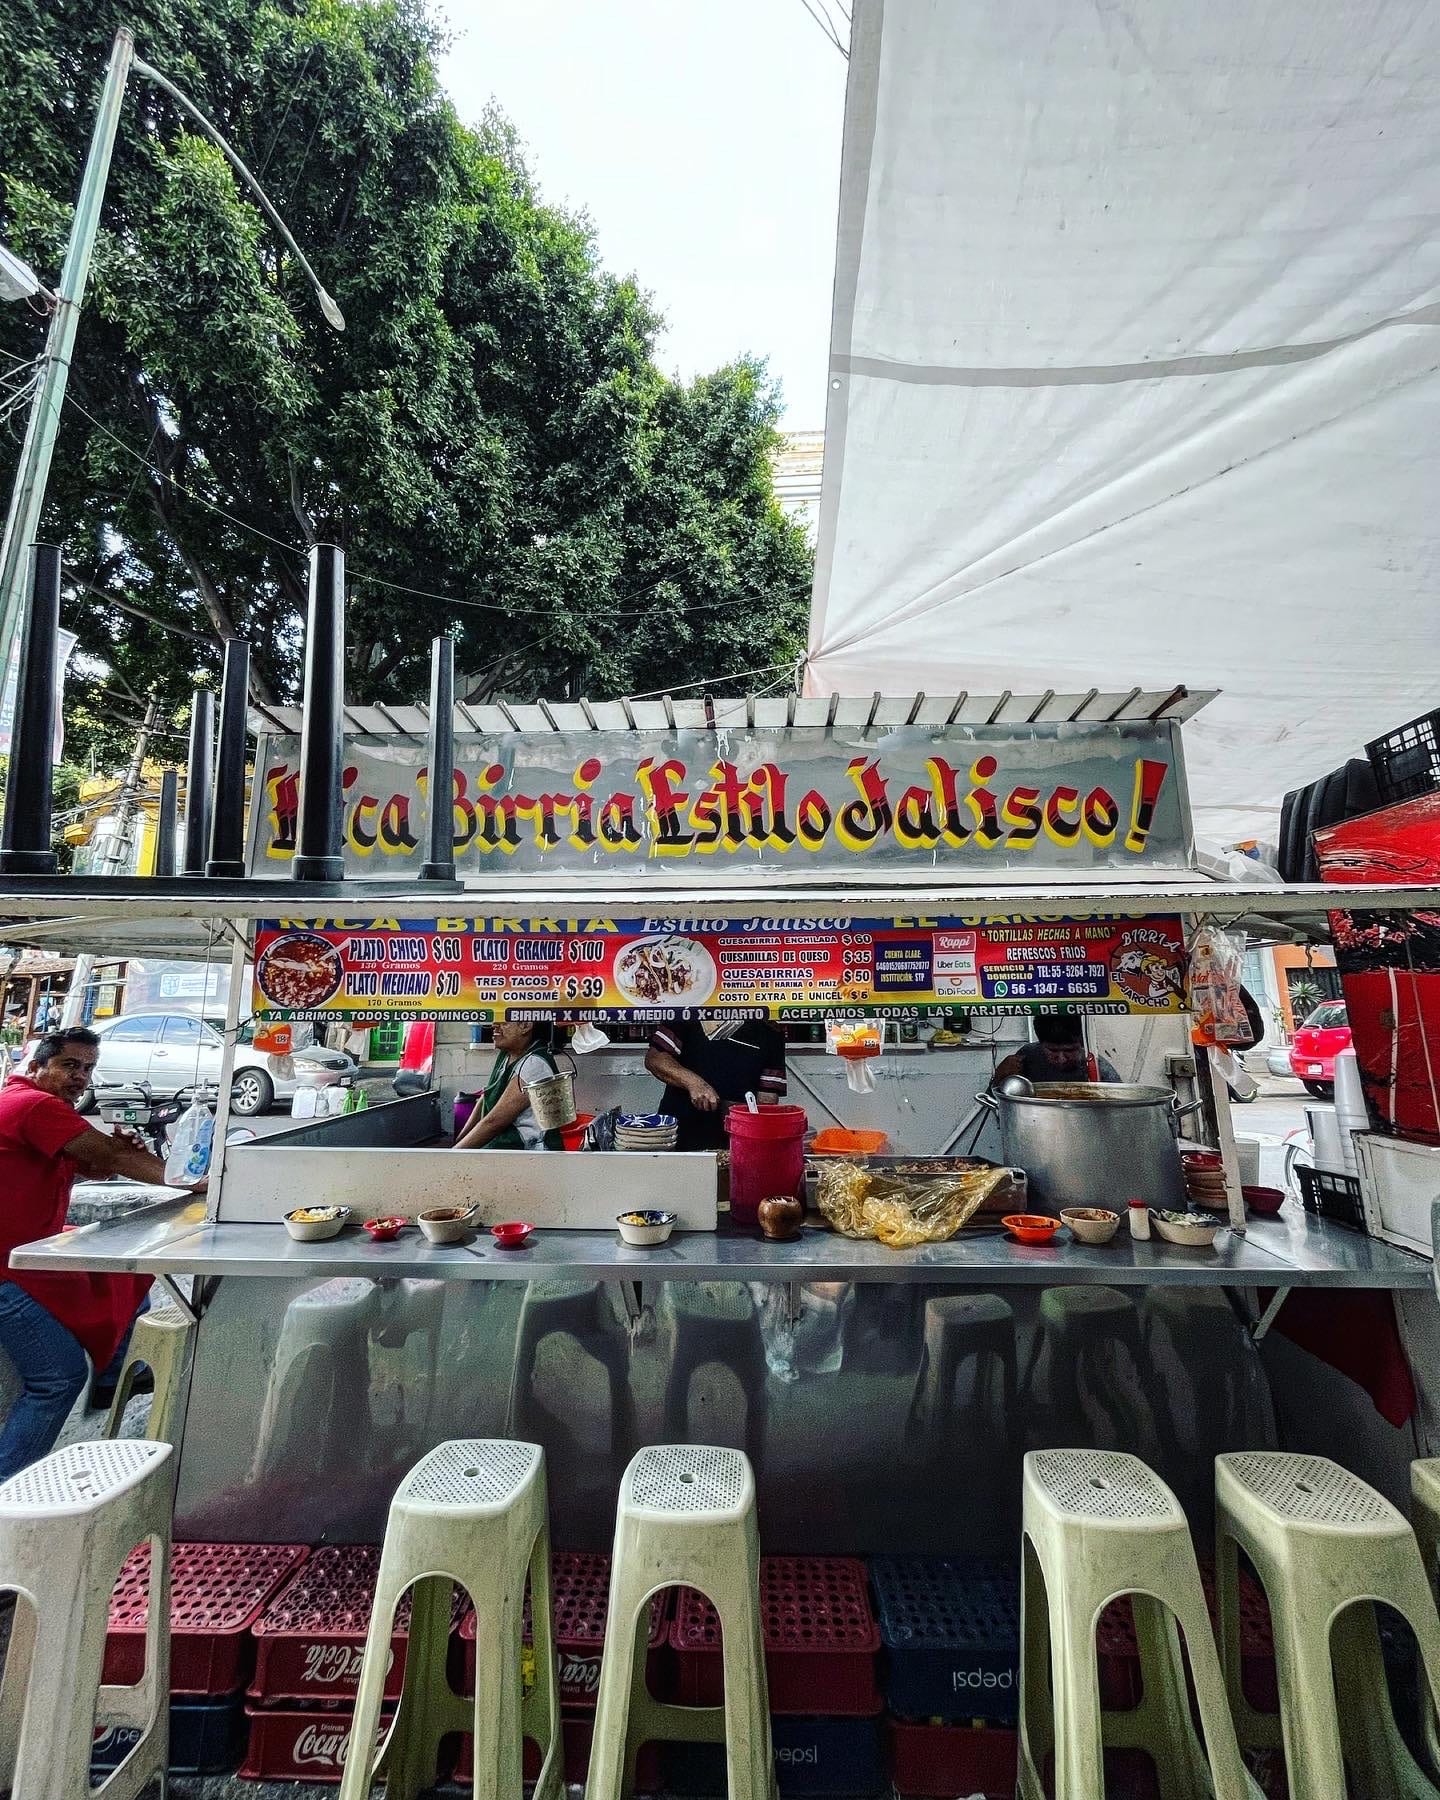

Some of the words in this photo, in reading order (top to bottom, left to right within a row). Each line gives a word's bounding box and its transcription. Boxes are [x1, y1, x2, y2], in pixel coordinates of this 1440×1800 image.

[267, 764, 419, 859] ca
[634, 757, 836, 858] Estilo
[719, 937, 780, 945] QUESABIRRIA
[785, 936, 837, 944] ENCHILADA
[1037, 928, 1070, 941] HECHAS
[1074, 928, 1081, 940] A
[1121, 928, 1181, 952] BIRRIA
[939, 935, 971, 949] Rappi
[348, 938, 385, 962] PLATO
[388, 938, 427, 961] CHICO
[473, 939, 509, 962] PLATO
[515, 939, 564, 962] GRANDE
[1006, 946, 1057, 961] REFRESCOS
[720, 951, 778, 963] QUESADILLAS
[783, 951, 795, 962] DE
[801, 951, 829, 962] QUESO
[382, 961, 421, 969] Gramos
[492, 963, 508, 971] 220
[512, 962, 549, 971] Gramos
[955, 960, 971, 968] Eats
[723, 969, 813, 979] QUESABIRRIAS
[1110, 972, 1125, 982] EL
[346, 972, 377, 996] PLATO
[381, 972, 431, 996] MEDIANO
[476, 977, 505, 986] TRES
[511, 977, 548, 986] TACOS
[553, 977, 562, 986] Y
[481, 991, 497, 1001] UN
[503, 989, 559, 1001] CONSOMÉ
[719, 993, 750, 1001] COSTO
[755, 993, 787, 1001] EXTRA
[791, 993, 803, 1001] DE
[809, 992, 843, 1000] UNICEL
[1120, 985, 1170, 1007] JAROCHO
[386, 999, 422, 1007] Gramos
[268, 1011, 282, 1021] YA
[289, 1011, 343, 1021] ABRIMOS
[351, 1011, 390, 1021] TODOS
[394, 1011, 418, 1021] LOS
[420, 1011, 487, 1021] DOMINGOS
[510, 1010, 556, 1021] BIRRIA:
[563, 1010, 571, 1021] X
[579, 1010, 611, 1022] KILO,
[617, 1010, 626, 1020] X
[633, 1009, 675, 1020] MEDIO
[682, 1006, 691, 1020] Ó
[781, 1008, 865, 1019] ACEPTAMOS
[873, 1007, 919, 1018] TODAS
[927, 1006, 954, 1017] LAS
[961, 1005, 1032, 1016] TARJETAS
[1040, 1004, 1058, 1015] DE
[1066, 1002, 1128, 1014] CRÉDITO
[301, 1645, 395, 1682] a-Cola
[952, 1667, 1013, 1691] pepsi
